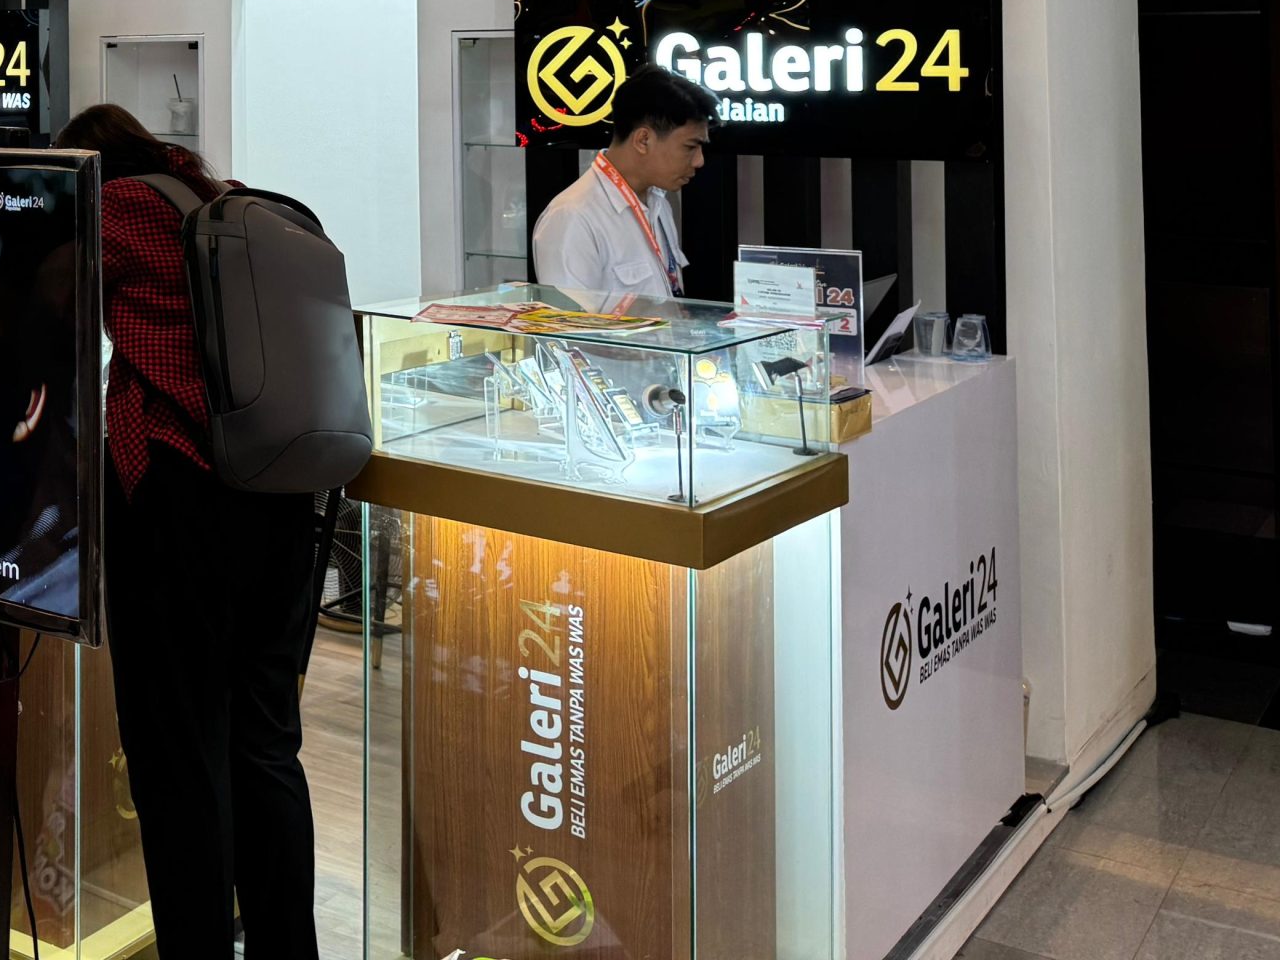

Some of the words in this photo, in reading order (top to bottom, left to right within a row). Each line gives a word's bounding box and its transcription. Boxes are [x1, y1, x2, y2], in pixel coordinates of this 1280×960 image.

[655, 27, 863, 92] Galeri
[876, 28, 969, 92] 24
[2, 92, 31, 109] WAS
[715, 97, 785, 122] daian
[5, 195, 32, 208] Galeri
[33, 196, 44, 208] 24
[827, 287, 854, 306] 24
[840, 318, 849, 330] 2
[568, 604, 584, 644] WAS
[918, 561, 974, 659] Galeri
[977, 546, 998, 614] 24
[518, 598, 561, 667] 24
[920, 660, 933, 684] BELI
[934, 646, 951, 672] EMAS
[952, 632, 970, 658] TANPA
[971, 619, 983, 641] WAS
[984, 607, 997, 630] WAS
[568, 645, 584, 685] WAS
[569, 688, 585, 744] TANPA
[518, 667, 563, 830] Galeri
[713, 734, 746, 780] Galeri
[747, 725, 761, 756] 24
[570, 748, 585, 797] EMAS
[571, 799, 585, 839] BELI
